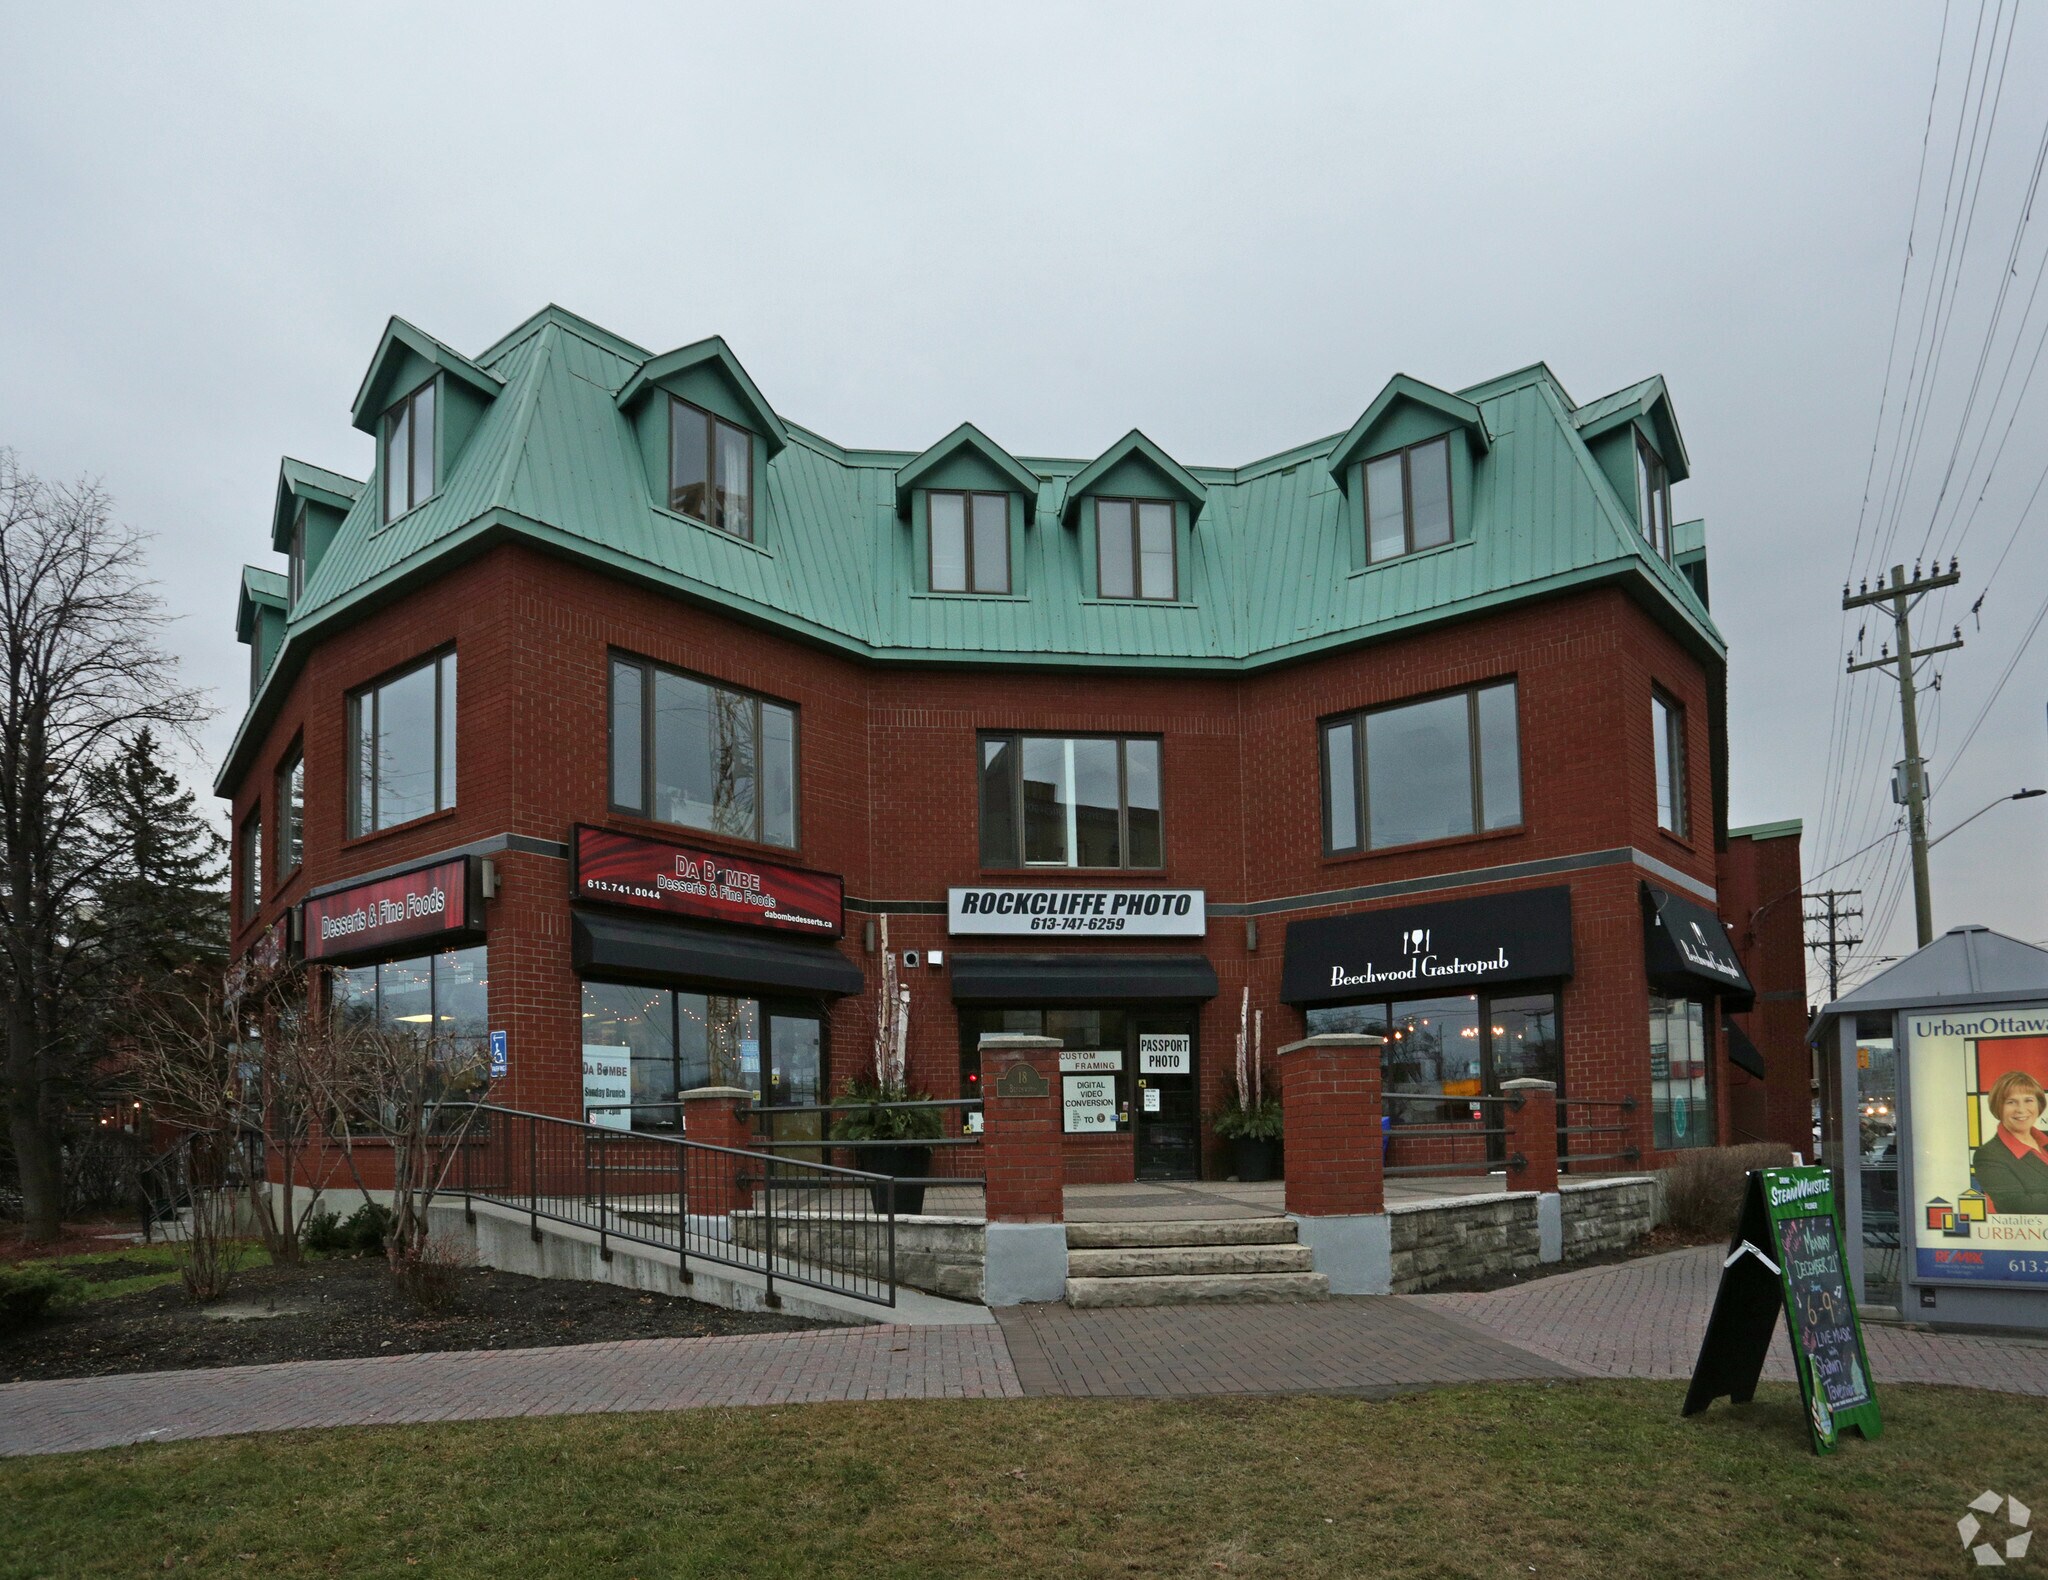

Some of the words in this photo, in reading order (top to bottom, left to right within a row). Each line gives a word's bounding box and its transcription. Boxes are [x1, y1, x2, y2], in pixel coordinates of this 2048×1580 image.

[587, 879, 661, 900] 613.741.0044
[657, 874, 706, 896] Desserts
[709, 884, 718, 898] &
[720, 885, 742, 903] Fine
[744, 890, 776, 909] Foods
[961, 892, 1107, 916] ROCKCLIFFE
[1110, 893, 1192, 917] PHOTO
[321, 908, 366, 940] Desserts
[368, 903, 377, 928] &
[378, 899, 404, 926] Fine
[406, 886, 445, 919] Foods
[764, 911, 833, 929] dabombedesserts.ca
[1030, 917, 1125, 931] 613-747-6259
[1330, 957, 1417, 987] Beechwood
[1421, 947, 1509, 977] Gastropub
[1916, 1017, 2048, 1038] UrbanOttaw
[1141, 1039, 1188, 1052] PASSPORT
[1060, 1052, 1096, 1060] CUSTOM
[1149, 1055, 1180, 1068] PHOTO
[1075, 1062, 1115, 1070] FRAMING
[1018, 1071, 1028, 1084] 18
[1077, 1081, 1105, 1089] DIGITAL
[585, 1087, 605, 1098] Sunday
[606, 1088, 625, 1098] Brunch
[1080, 1090, 1103, 1098] VIDEO
[1065, 1099, 1114, 1108] CONVERSION
[1084, 1116, 1094, 1124] TO
[1992, 1215, 2043, 1226] Natalie's
[1794, 1257, 1829, 1279] DECEMBER
